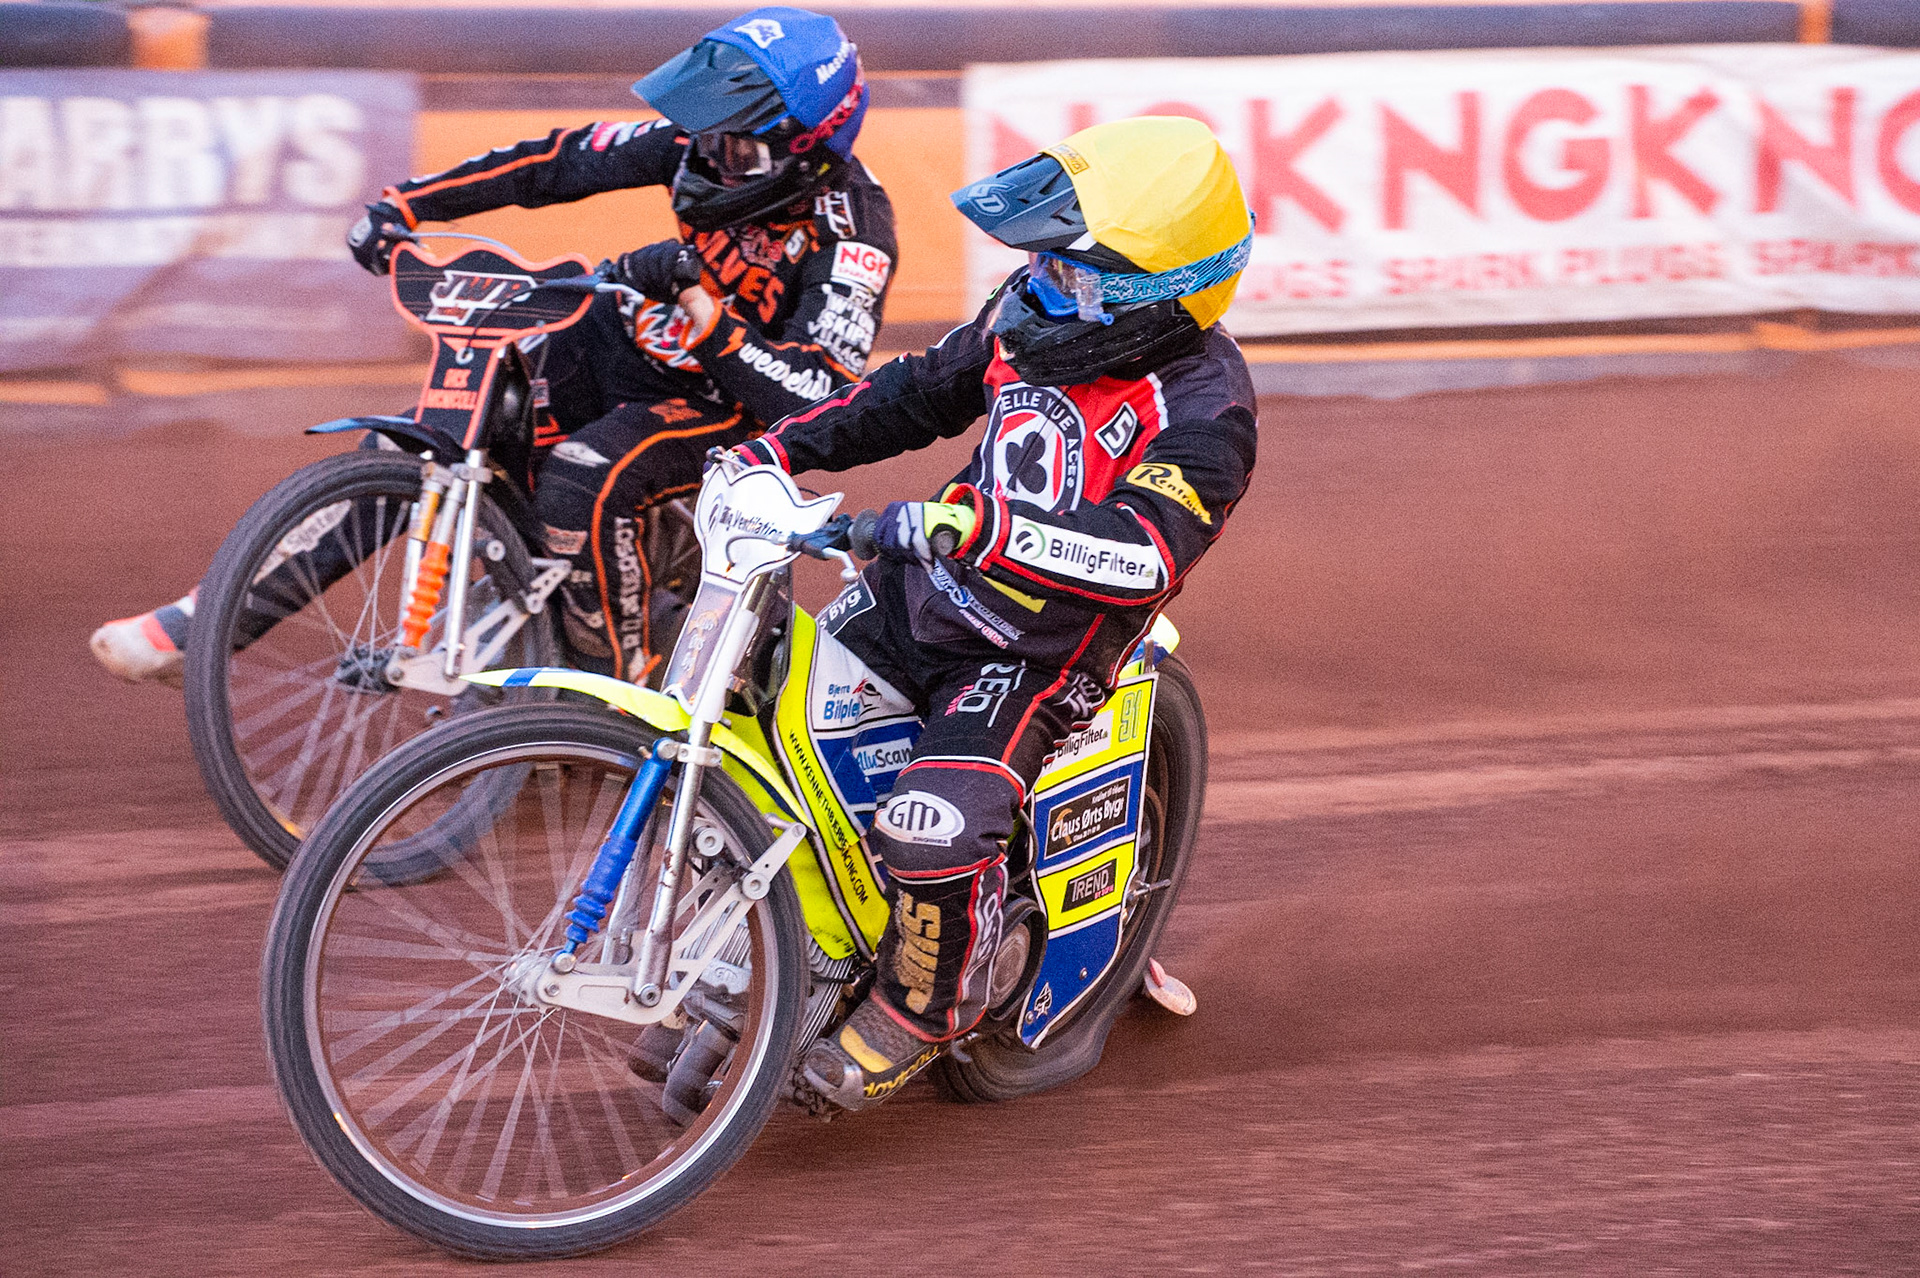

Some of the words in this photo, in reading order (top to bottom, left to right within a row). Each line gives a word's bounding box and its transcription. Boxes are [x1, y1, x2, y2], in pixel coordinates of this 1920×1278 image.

[1377, 83, 1721, 231] NGK
[840, 245, 888, 278] NGK
[1000, 391, 1043, 412] ELLE
[1045, 397, 1076, 432] VUE
[1066, 437, 1080, 489] ACES
[1103, 409, 1134, 449] 5
[1118, 689, 1143, 743] 91
[888, 800, 941, 831] GM
[1051, 815, 1081, 842] Claus
[1069, 862, 1111, 902] TREND
